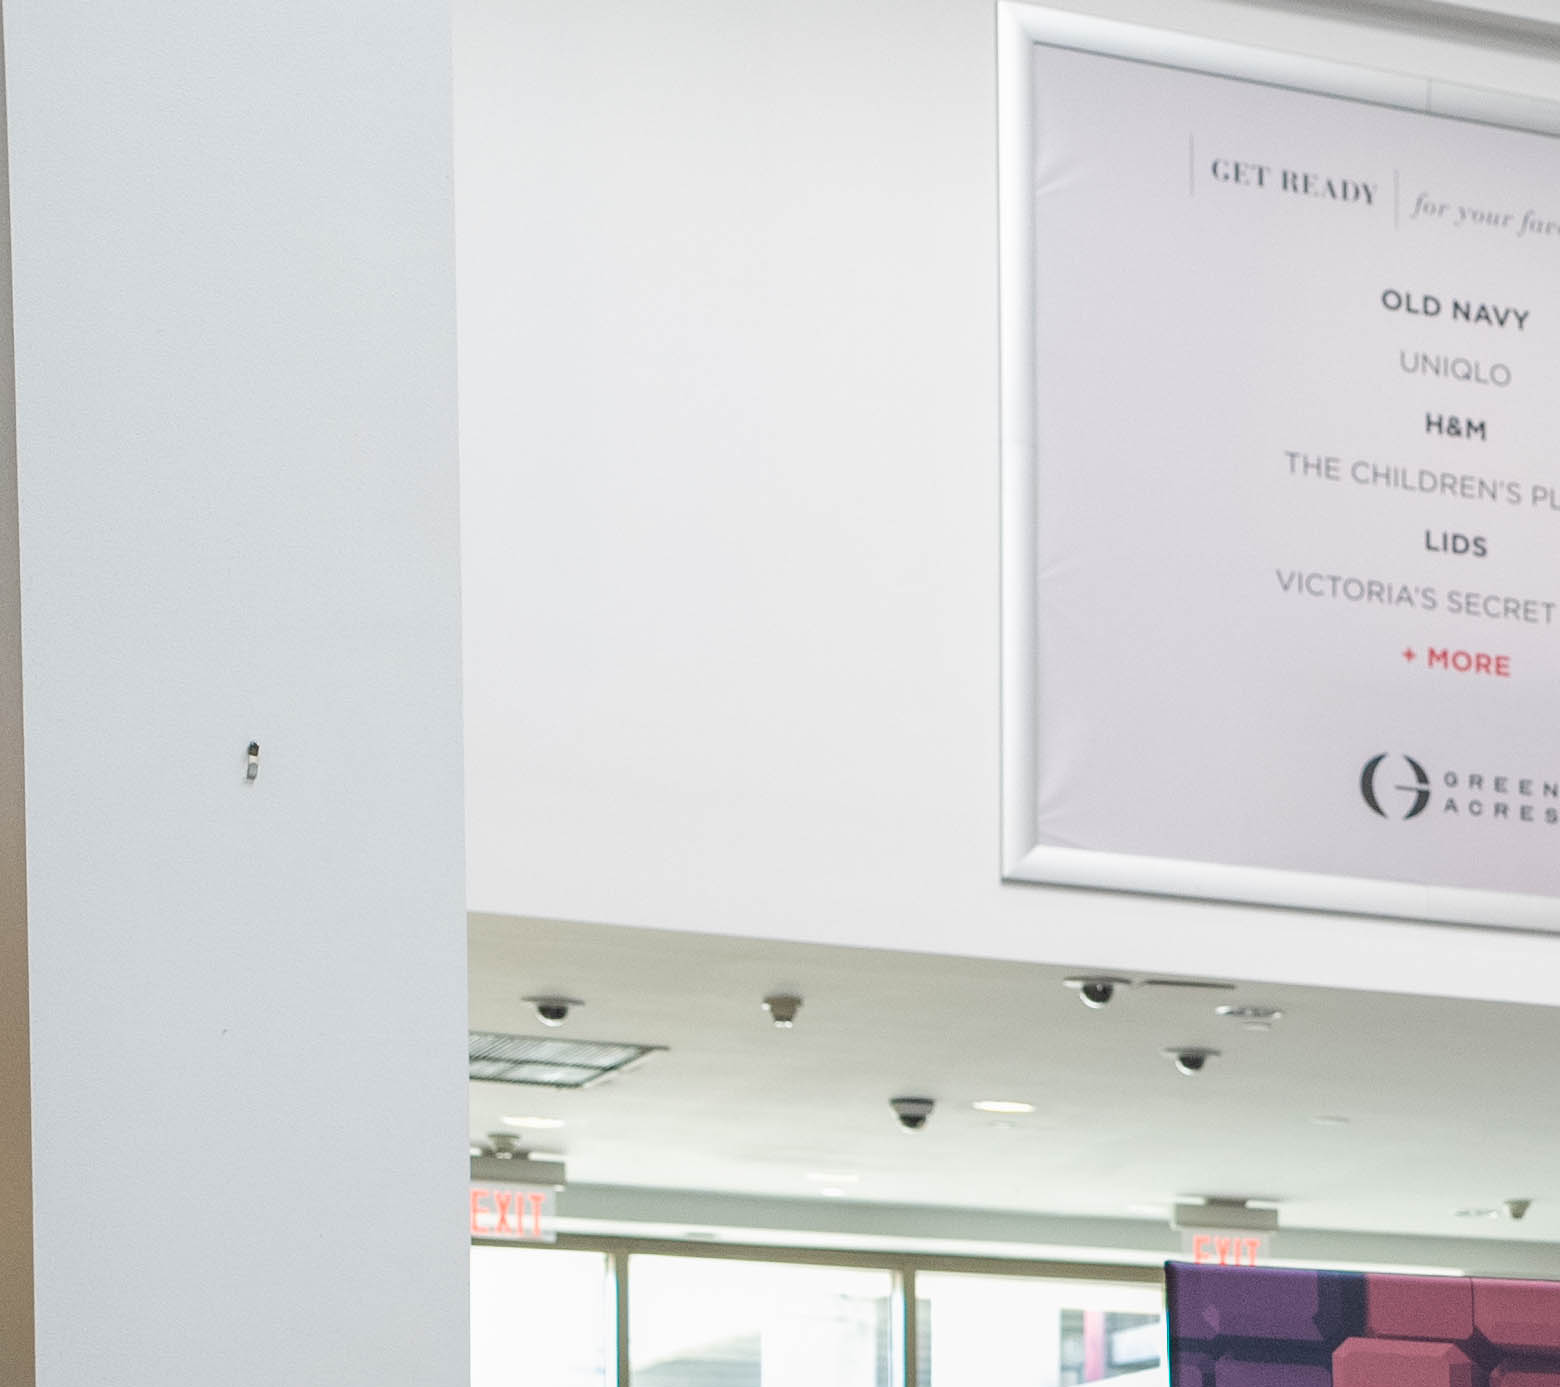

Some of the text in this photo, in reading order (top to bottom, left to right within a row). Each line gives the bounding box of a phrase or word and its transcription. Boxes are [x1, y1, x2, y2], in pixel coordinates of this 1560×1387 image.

[1211, 158, 1379, 206] GET READY
[1411, 192, 1448, 219] for
[1455, 203, 1515, 228] your
[1381, 288, 1531, 332] OLD NAVY
[1399, 349, 1512, 389] UNIQLO
[1425, 412, 1488, 442] H&M
[1284, 450, 1341, 482] THE
[1351, 460, 1523, 505] CHILDREN'S
[1425, 529, 1489, 558] LIDS
[1275, 568, 1439, 612] VICTORIA'S
[1446, 590, 1556, 625] SECRET
[1428, 647, 1512, 677] MORE
[1443, 771, 1560, 798] GREEN
[1443, 798, 1560, 825] ACRES
[470, 1186, 546, 1237] EXIT
